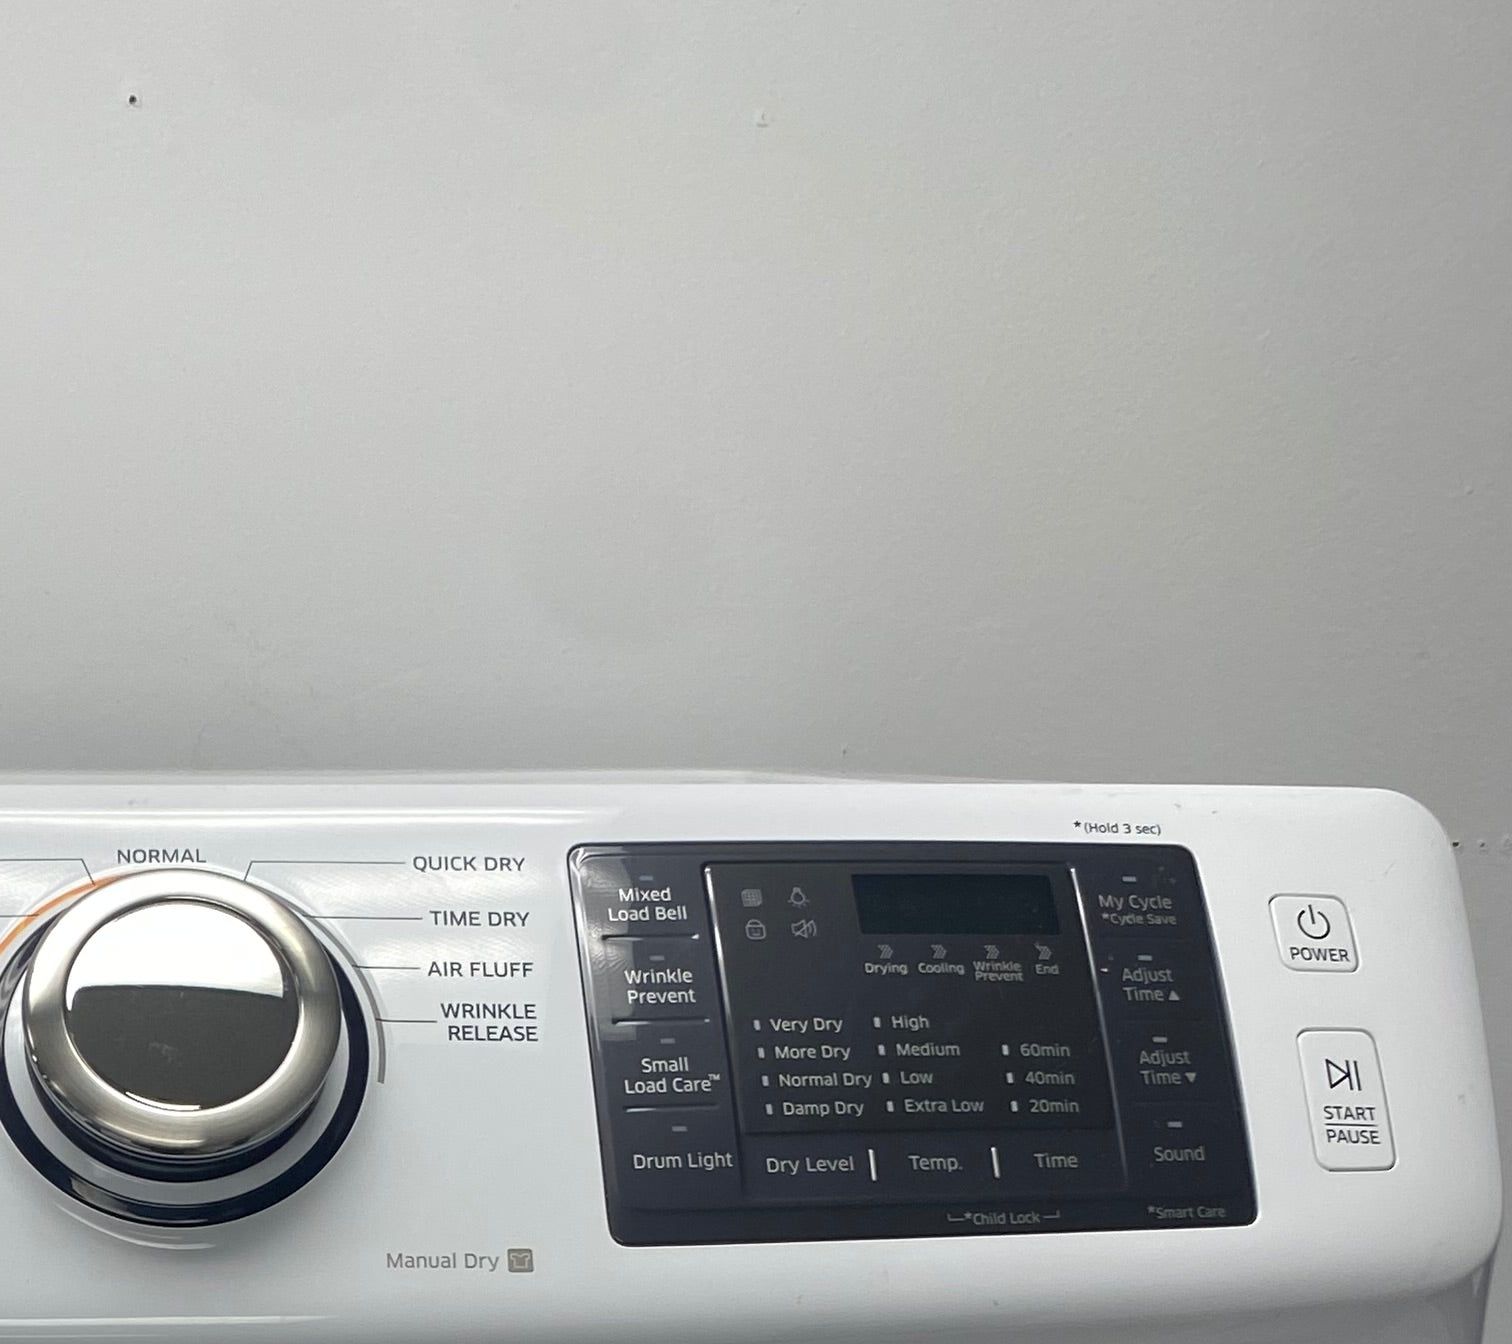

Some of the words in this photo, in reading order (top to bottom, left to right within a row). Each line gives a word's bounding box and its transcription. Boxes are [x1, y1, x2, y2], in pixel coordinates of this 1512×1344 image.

[1123, 823, 1131, 834] 3
[1135, 824, 1161, 836] sec)
[117, 848, 207, 864] NORMAL
[413, 856, 477, 872] QUICK
[484, 857, 525, 871] DRY
[619, 887, 672, 902] Mixed
[1098, 895, 1125, 911] My
[1128, 895, 1172, 911] Cycle
[429, 910, 481, 926] TIME
[488, 911, 530, 927] DRY
[608, 908, 650, 922] Load
[656, 905, 687, 921] Bell
[1289, 947, 1350, 963] POWER
[427, 961, 463, 977] AIR
[470, 962, 534, 977] FLUFF
[865, 962, 908, 976] Drying
[918, 962, 965, 976] Cooling
[973, 960, 1022, 971] Wrinkle
[1035, 964, 1059, 975] End
[624, 969, 693, 985] Wrinkle
[975, 971, 1024, 982] Prevent
[1121, 967, 1173, 984] Adjust
[627, 989, 697, 1005] Prevent
[1122, 986, 1164, 1002] Time
[440, 1003, 537, 1019] WRINKLE
[770, 1017, 809, 1033] Very
[813, 1017, 843, 1033] Dry
[891, 1015, 930, 1031] High
[448, 1025, 539, 1042] RELEASE
[775, 1045, 817, 1059] More
[822, 1045, 851, 1061] Dry
[896, 1043, 961, 1057] Medium
[1020, 1043, 1071, 1057] 60min
[641, 1057, 689, 1072] Small
[1139, 1050, 1190, 1067] Adjust
[779, 1072, 838, 1087] Normal
[842, 1072, 872, 1089] Dry
[900, 1071, 933, 1084] Low
[1025, 1071, 1076, 1085] 40min
[1140, 1070, 1181, 1085] Time
[624, 1078, 666, 1094] Load
[783, 1101, 830, 1117] Damp
[835, 1101, 864, 1117] Dry
[904, 1098, 947, 1113] Extra
[951, 1098, 984, 1113] Low
[1029, 1098, 1080, 1113] 20min
[1323, 1105, 1376, 1121] START
[1326, 1129, 1381, 1145] PAUSE
[633, 1154, 681, 1170] Drum
[687, 1152, 733, 1171] Light
[1034, 1152, 1078, 1169] Time
[1153, 1146, 1205, 1162] Sound
[766, 1158, 800, 1175] Dry
[806, 1156, 855, 1172] Level
[908, 1155, 963, 1172] Temp.
[1010, 1212, 1041, 1225] Lock
[1197, 1206, 1227, 1218] Care
[386, 1252, 457, 1269] Manual
[464, 1253, 500, 1272] Dry
